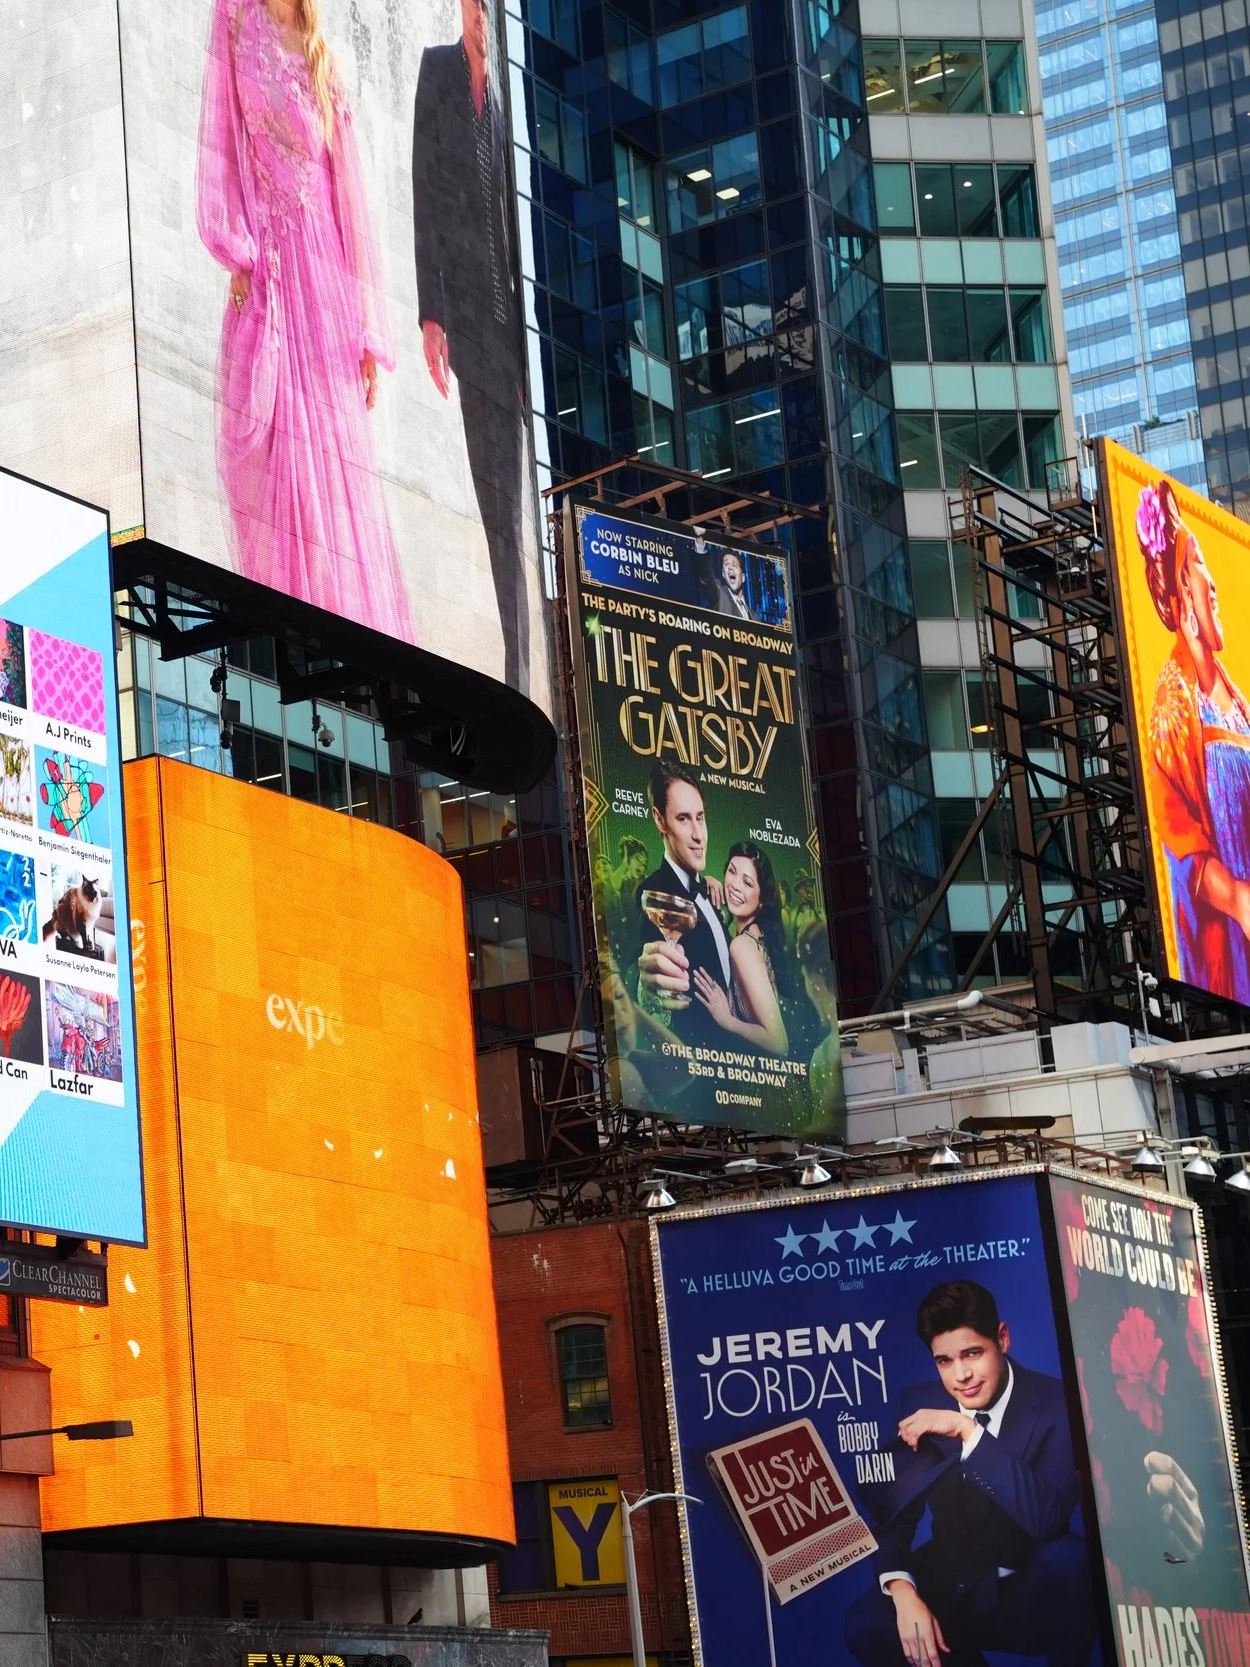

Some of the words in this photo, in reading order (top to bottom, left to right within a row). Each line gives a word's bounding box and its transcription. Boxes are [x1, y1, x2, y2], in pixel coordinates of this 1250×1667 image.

[590, 540, 642, 566] CORBIN
[646, 555, 679, 574] BLEU
[597, 528, 622, 544] NOW
[626, 536, 674, 557] STARRING
[618, 565, 631, 577] AS
[634, 568, 659, 584] NICK
[582, 592, 605, 610] THE
[608, 598, 656, 624] PARTY'S
[658, 612, 710, 636] ROARING
[712, 625, 730, 640] ON
[733, 630, 793, 655] BROADWAY
[589, 621, 660, 695] THE
[669, 644, 796, 724] GREAT
[46, 723, 61, 738] A.J
[64, 725, 92, 748] Prints
[620, 696, 778, 780] GATSBY
[615, 788, 644, 804] REEVE
[700, 772, 707, 782] A
[708, 774, 727, 786] NEW
[728, 778, 766, 794] MUSICAL
[612, 802, 649, 819] CARNEY
[766, 818, 782, 832] EVA
[38, 836, 70, 854] Benjamin
[71, 846, 111, 865] Siegenthaler
[750, 828, 800, 848] NOBLEZADA
[46, 954, 71, 970] Susanne
[72, 960, 88, 976] Layla
[90, 965, 116, 980] Petersen
[6, 1062, 28, 1080] Can
[688, 1062, 714, 1078] 53RD
[717, 1066, 726, 1078] &
[728, 1067, 788, 1088] BROADWAY
[695, 1048, 756, 1068] BROADWAY
[758, 1057, 807, 1076] THEATRE
[50, 1069, 94, 1096] Lazfar
[730, 1094, 762, 1108] COMPANY
[1081, 1194, 1110, 1232] COME
[1110, 1201, 1130, 1236] SEE
[1130, 1206, 1154, 1242] HOW
[1152, 1212, 1174, 1248] THE
[703, 1268, 774, 1293] HELLUVA
[778, 1258, 840, 1284] GOOD
[845, 1255, 886, 1276] TIME
[889, 1256, 909, 1272] at
[913, 1250, 943, 1268] the
[1066, 1225, 1124, 1278] WORLD
[1124, 1242, 1176, 1292] COULD
[1176, 1256, 1198, 1298] BE
[49, 1284, 102, 1300] SPECTACOLOR
[696, 1318, 887, 1366] JEREMY
[702, 1354, 888, 1420] JORDAN
[837, 1410, 856, 1422] is
[838, 1422, 879, 1454] BOBBY
[734, 1448, 803, 1504] JUST
[799, 1452, 820, 1476] in
[855, 1452, 896, 1484] DARIN
[558, 1486, 608, 1500] MUSICAL
[747, 1477, 847, 1536] TIME
[552, 1502, 618, 1582] Y
[790, 1583, 798, 1594] A
[800, 1567, 825, 1588] NEW
[827, 1544, 872, 1572] MUSICAL
